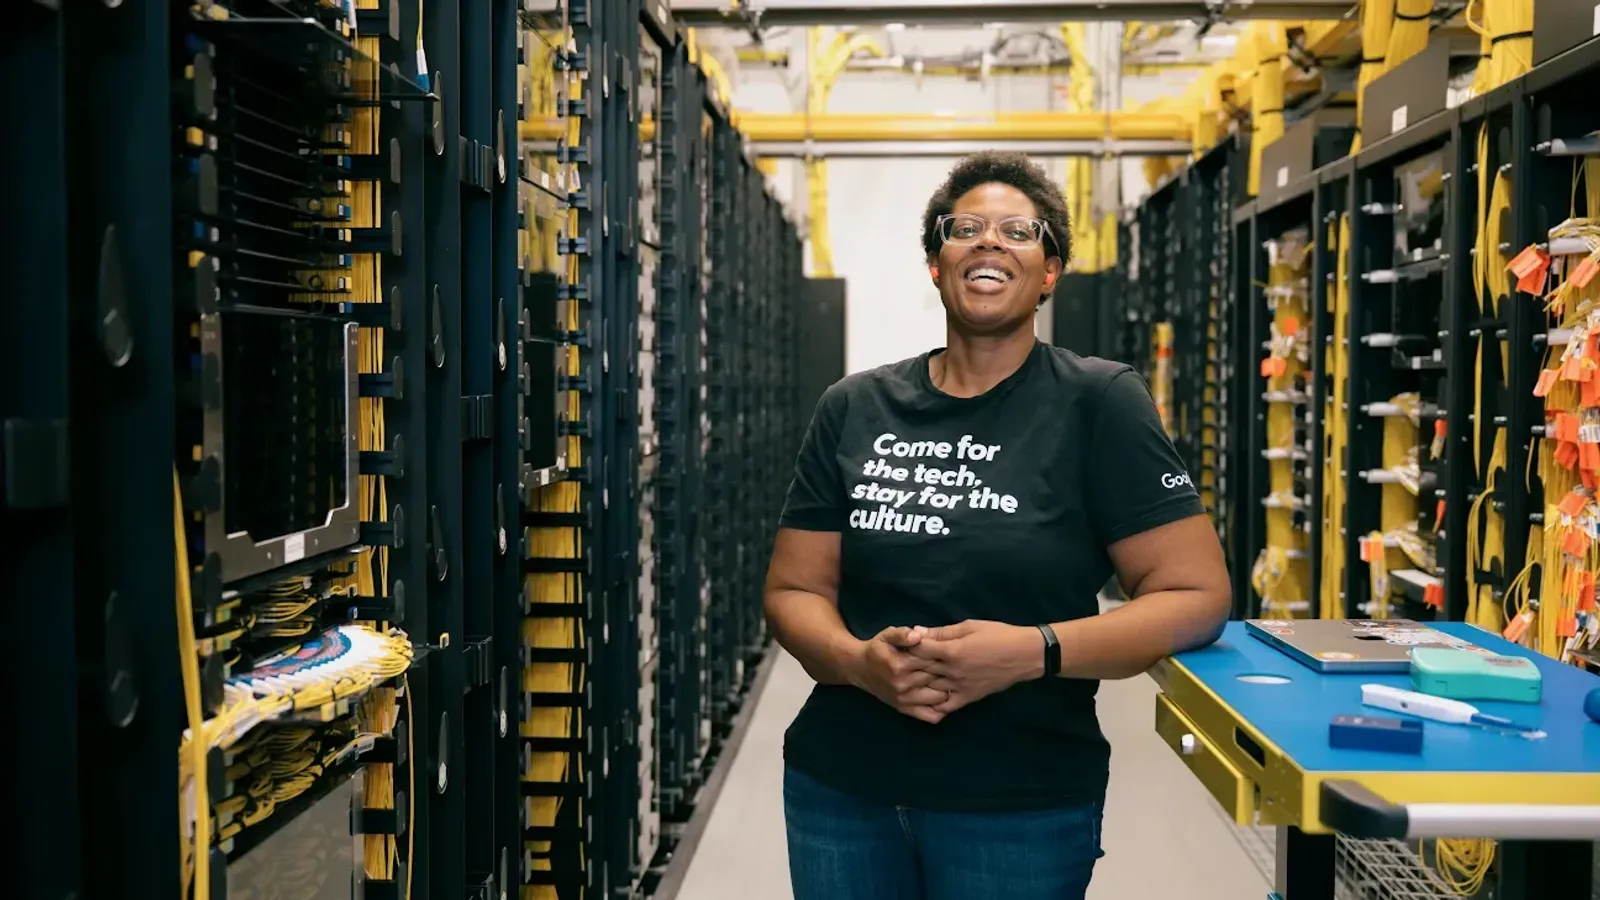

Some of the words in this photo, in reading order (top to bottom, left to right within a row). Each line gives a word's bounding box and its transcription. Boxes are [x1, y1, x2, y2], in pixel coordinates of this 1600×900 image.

[873, 433, 952, 459] Come
[957, 435, 1001, 461] for
[863, 458, 909, 481] the
[914, 463, 982, 488] tech,
[851, 482, 916, 508] stay
[918, 486, 963, 509] for
[968, 487, 1018, 513] the
[850, 504, 950, 535] culture.
